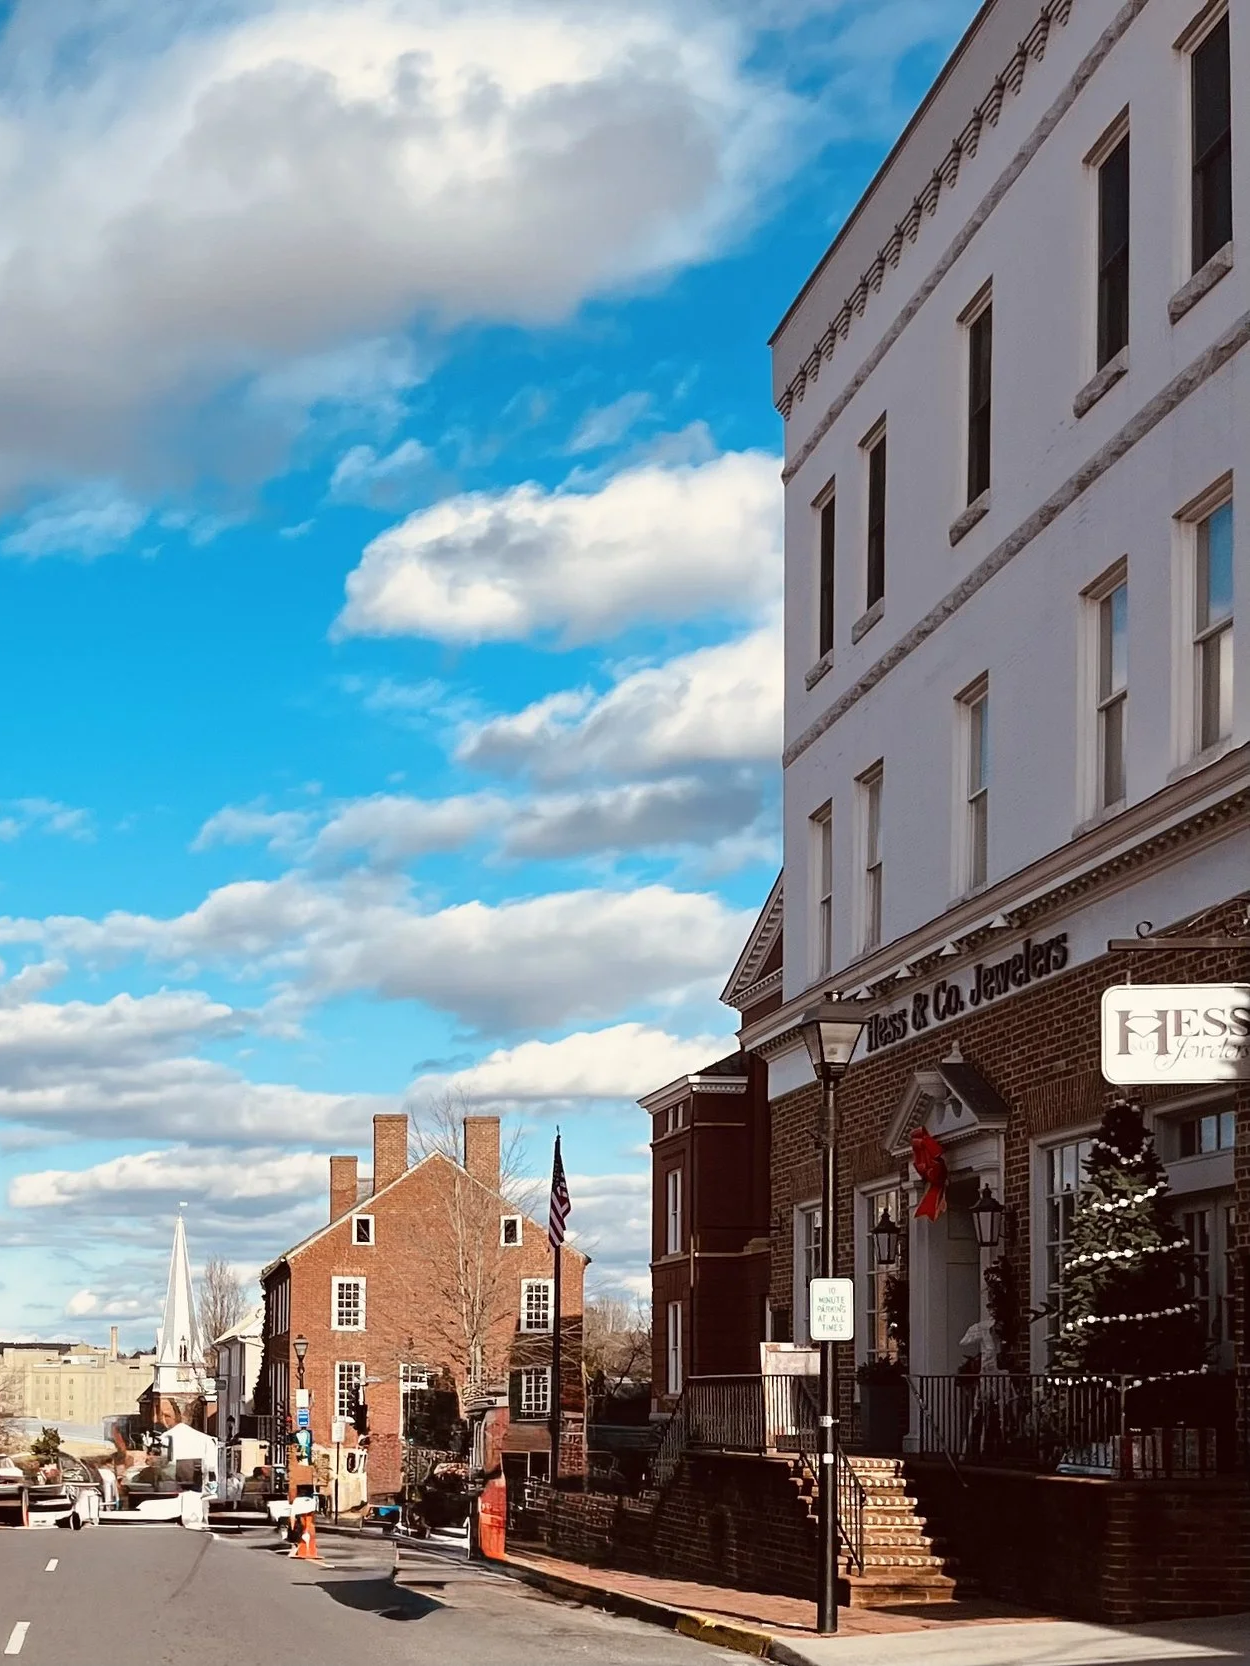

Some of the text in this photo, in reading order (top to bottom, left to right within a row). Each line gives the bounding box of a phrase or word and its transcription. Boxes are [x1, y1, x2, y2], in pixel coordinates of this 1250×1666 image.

[866, 932, 1068, 1052] Hess & Co. Jewelers
[1114, 1007, 1250, 1056] HESS
[1153, 1036, 1250, 1072] Jewelers
[818, 1296, 846, 1304] MINUTE
[818, 1314, 845, 1323] AT ALL
